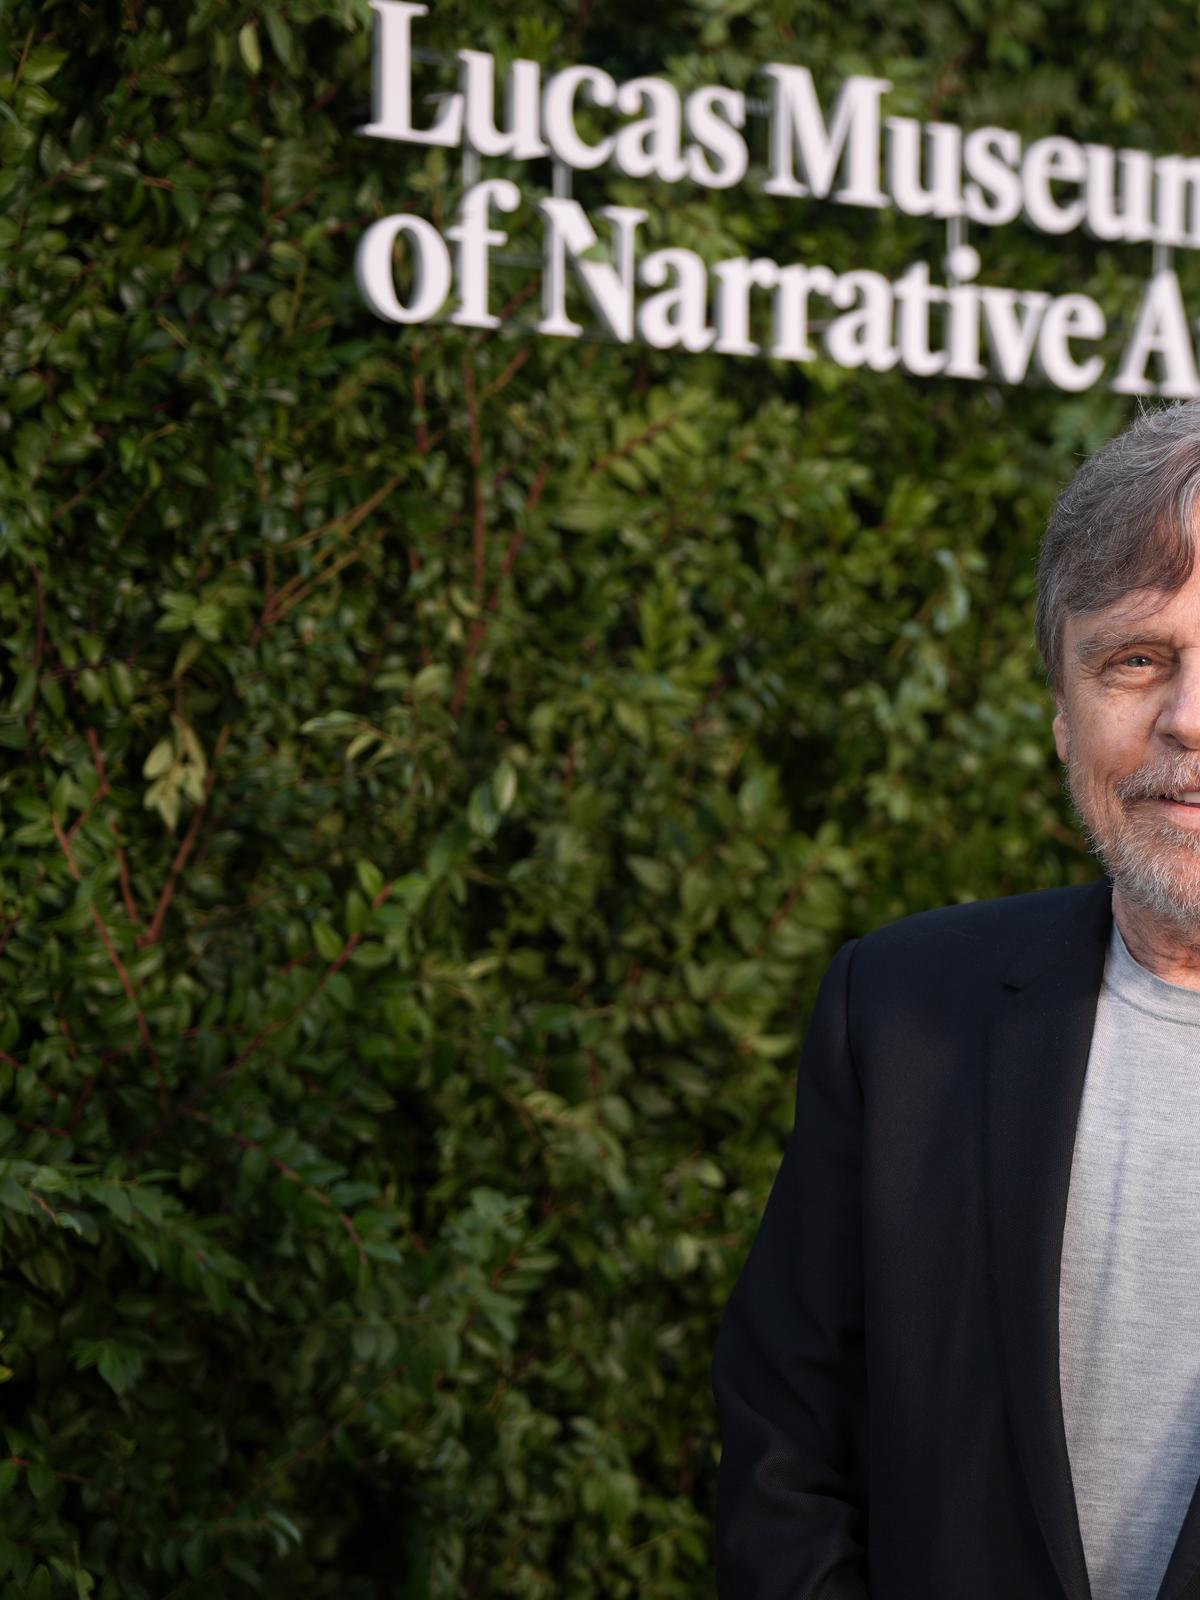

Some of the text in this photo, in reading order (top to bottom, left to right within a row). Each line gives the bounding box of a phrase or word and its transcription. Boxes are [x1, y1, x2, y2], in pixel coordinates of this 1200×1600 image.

[359, 0, 748, 189] Lucas
[355, 180, 520, 330] of
[536, 199, 1106, 390] Narrative
